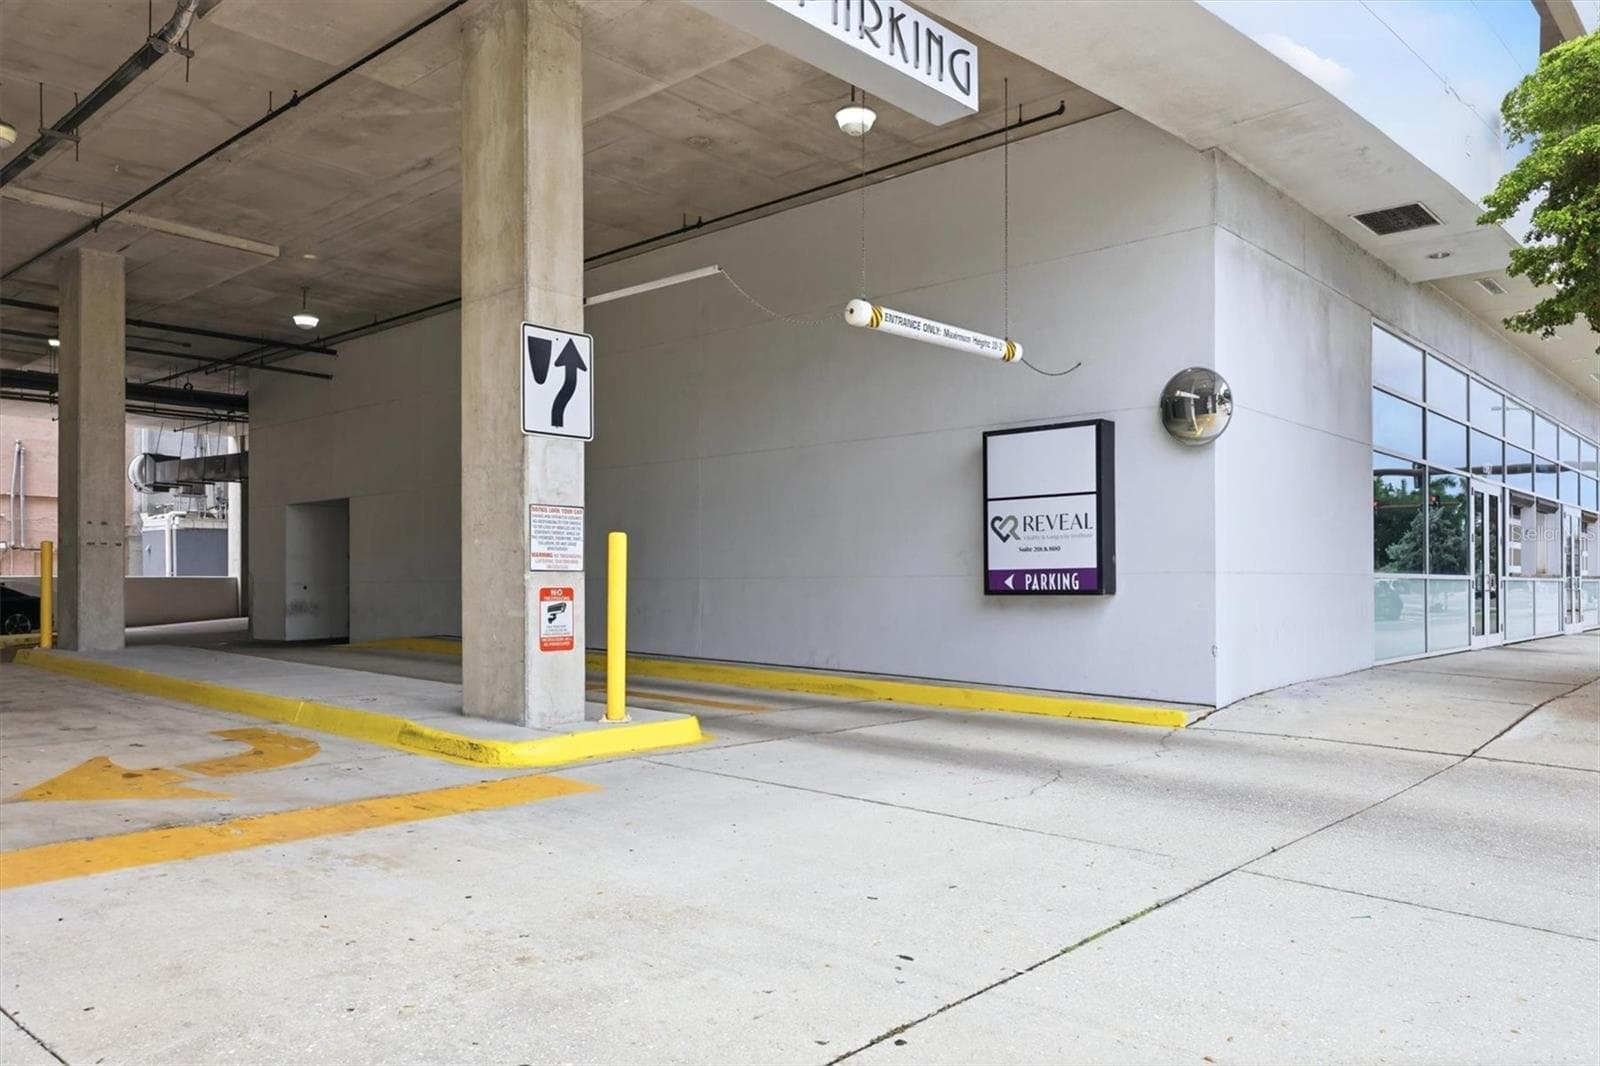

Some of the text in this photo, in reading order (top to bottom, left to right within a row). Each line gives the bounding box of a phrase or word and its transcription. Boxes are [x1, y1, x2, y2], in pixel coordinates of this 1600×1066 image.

[884, 313, 921, 330] ENTRANCE
[1023, 512, 1094, 533] REVEAL
[1025, 572, 1080, 591] PARKING
[550, 589, 563, 597] NO
